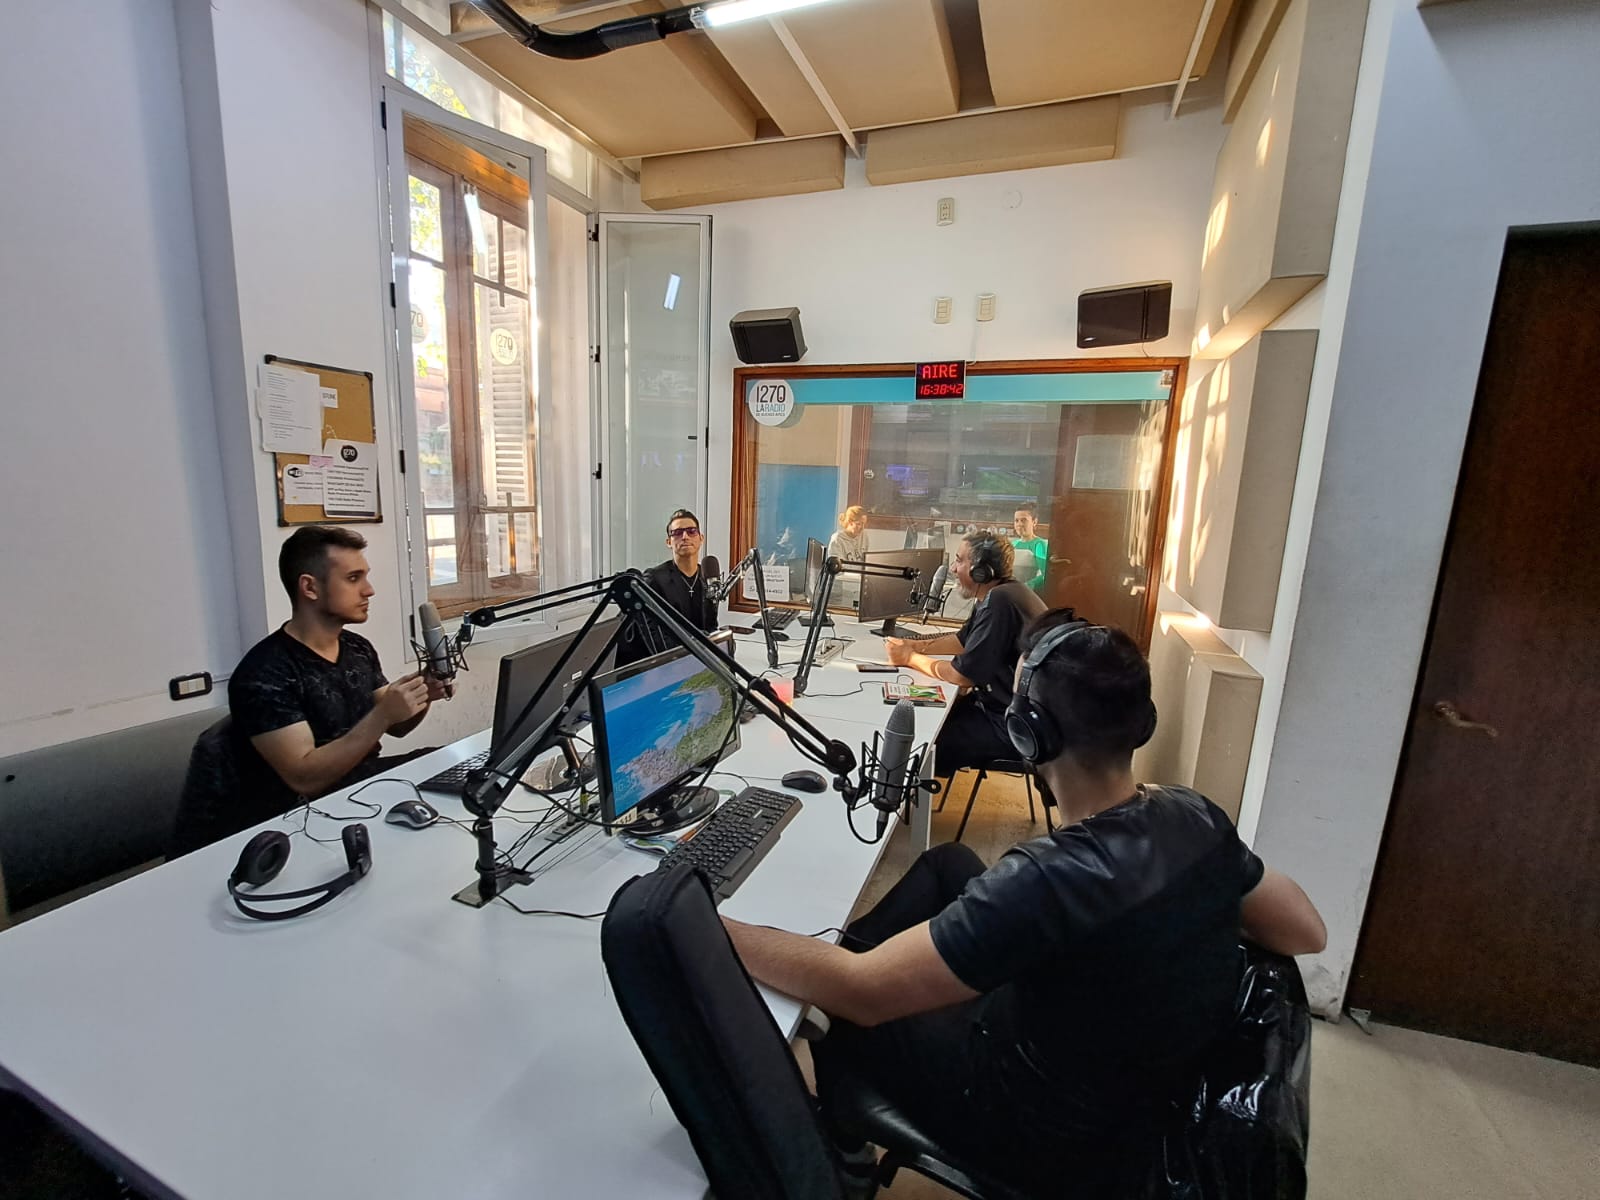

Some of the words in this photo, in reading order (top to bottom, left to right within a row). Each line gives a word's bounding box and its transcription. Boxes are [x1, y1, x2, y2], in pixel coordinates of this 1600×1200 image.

[496, 333, 513, 350] 1270
[922, 364, 958, 379] AIRE
[756, 385, 786, 403] 1270
[920, 384, 964, 395] 16:38:42
